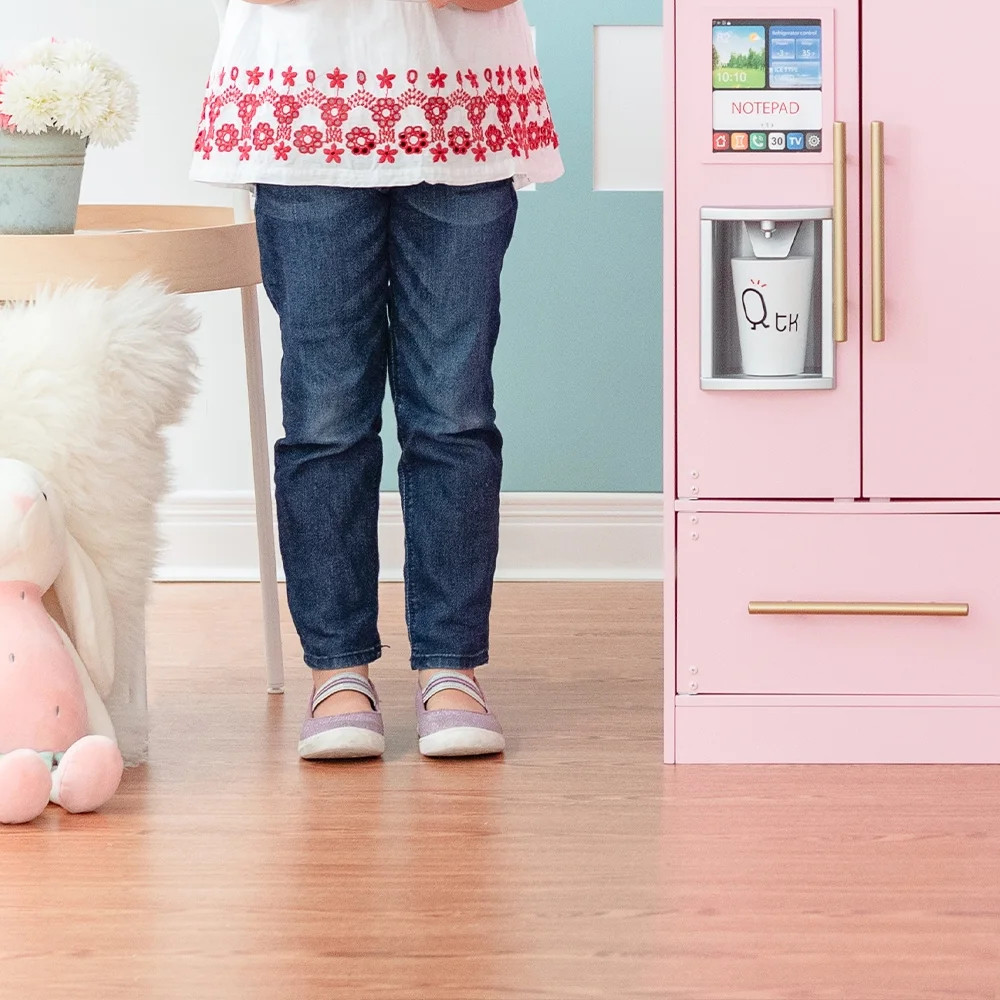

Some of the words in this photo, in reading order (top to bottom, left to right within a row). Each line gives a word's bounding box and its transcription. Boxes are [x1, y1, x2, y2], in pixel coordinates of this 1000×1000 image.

[717, 72, 747, 83] 10:10
[731, 101, 800, 115] NOTEPAD
[771, 137, 783, 146] 30
[789, 137, 802, 146] TV
